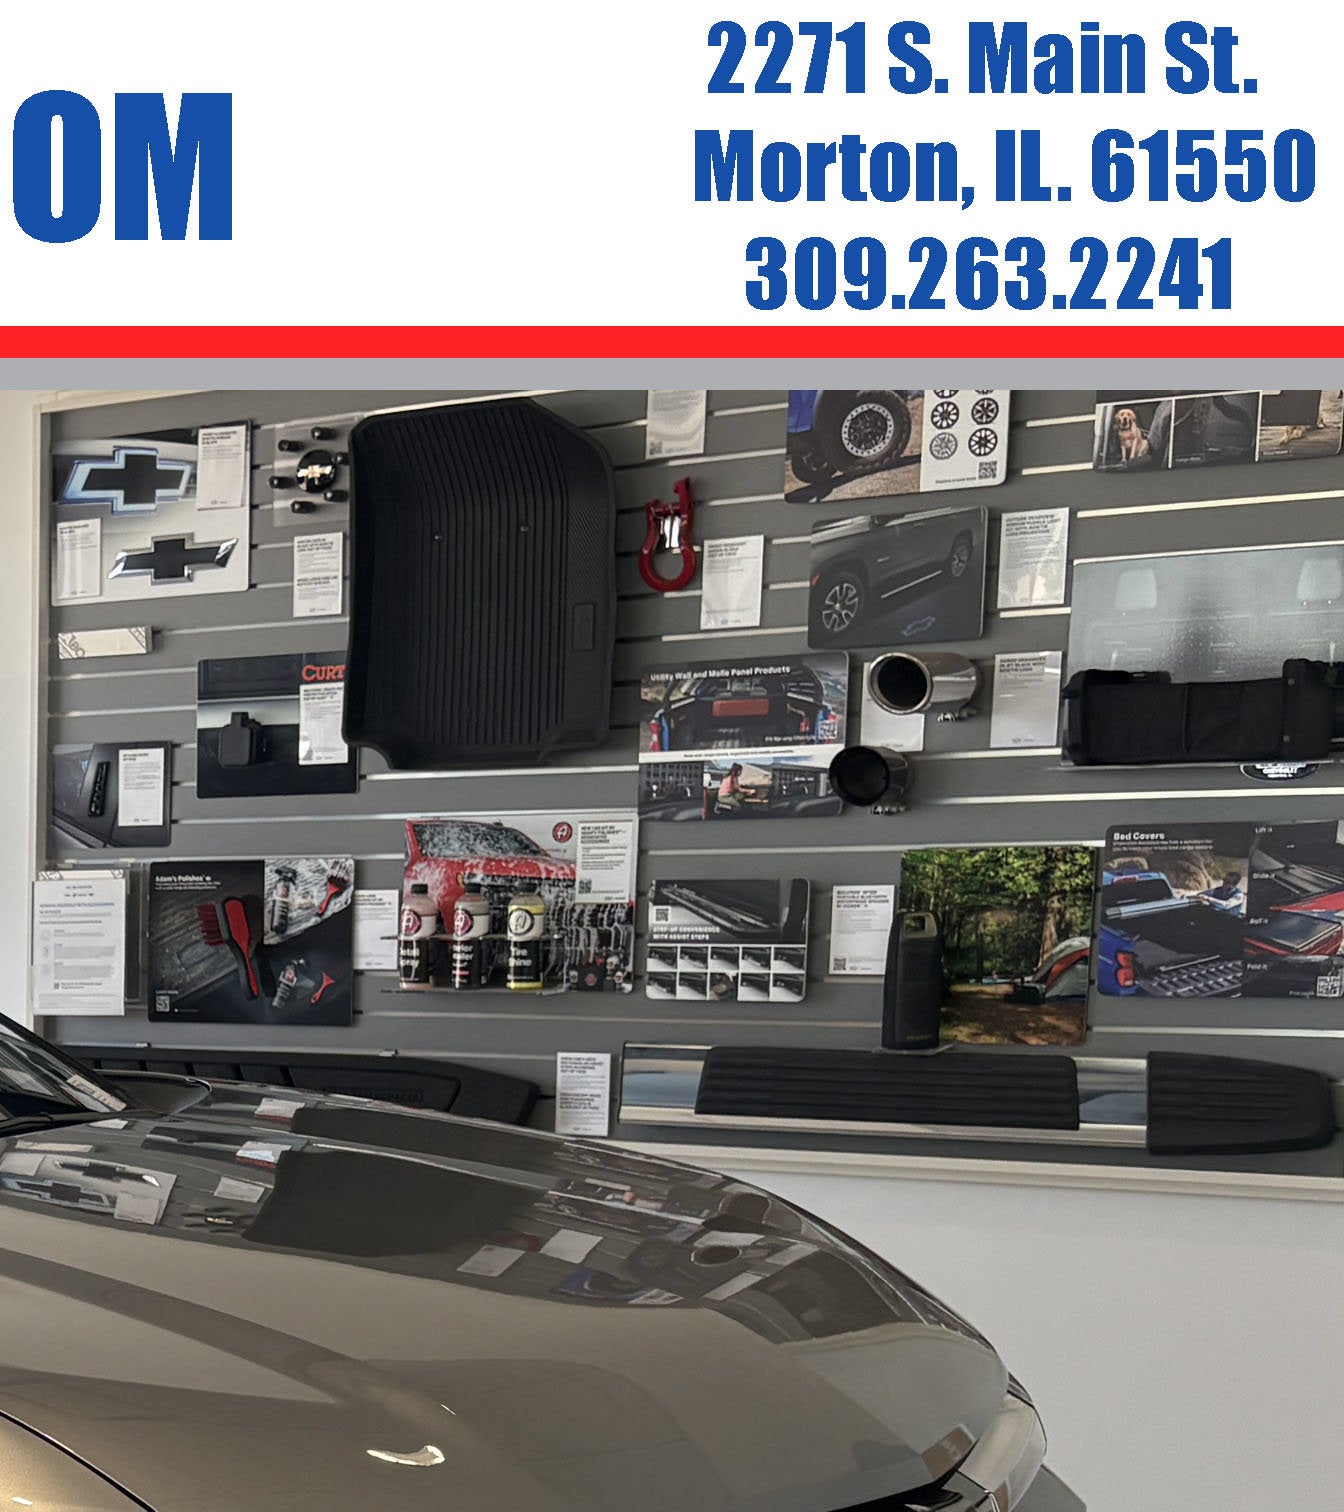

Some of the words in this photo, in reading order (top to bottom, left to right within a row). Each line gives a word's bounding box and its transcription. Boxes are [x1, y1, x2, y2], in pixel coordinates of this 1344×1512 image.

[301, 664, 346, 682] CURT
[650, 672, 674, 682] Utility
[675, 671, 692, 680] Wall
[693, 671, 707, 679] and
[709, 669, 729, 678] Molle
[731, 667, 753, 677] Panel
[754, 665, 791, 676] Products
[1113, 832, 1131, 841] Bed
[1133, 832, 1165, 841] Covers
